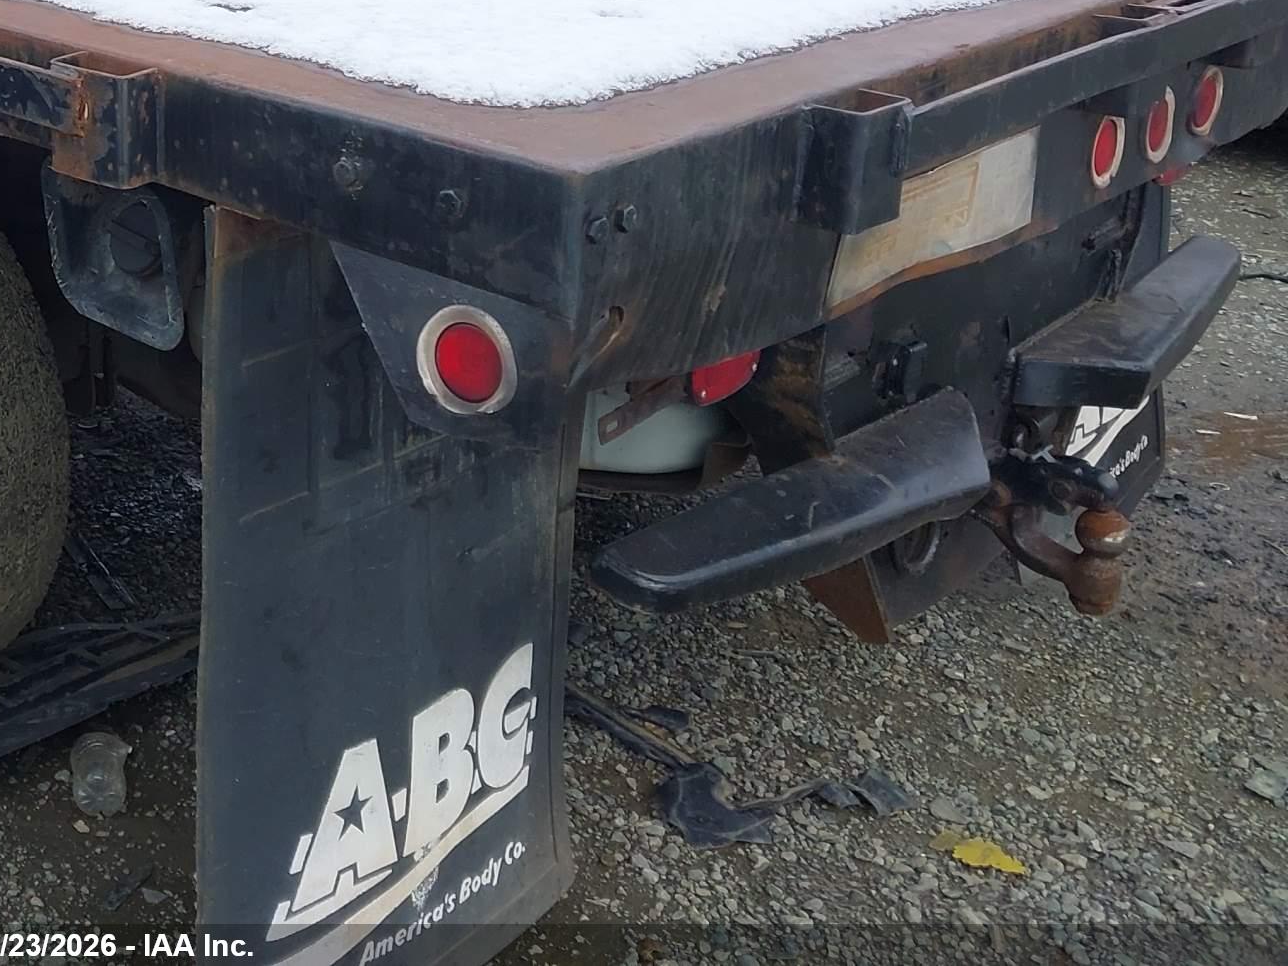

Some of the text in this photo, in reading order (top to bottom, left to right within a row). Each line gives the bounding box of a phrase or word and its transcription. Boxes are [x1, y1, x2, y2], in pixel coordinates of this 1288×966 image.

[359, 841, 526, 966] America's Body Co.
